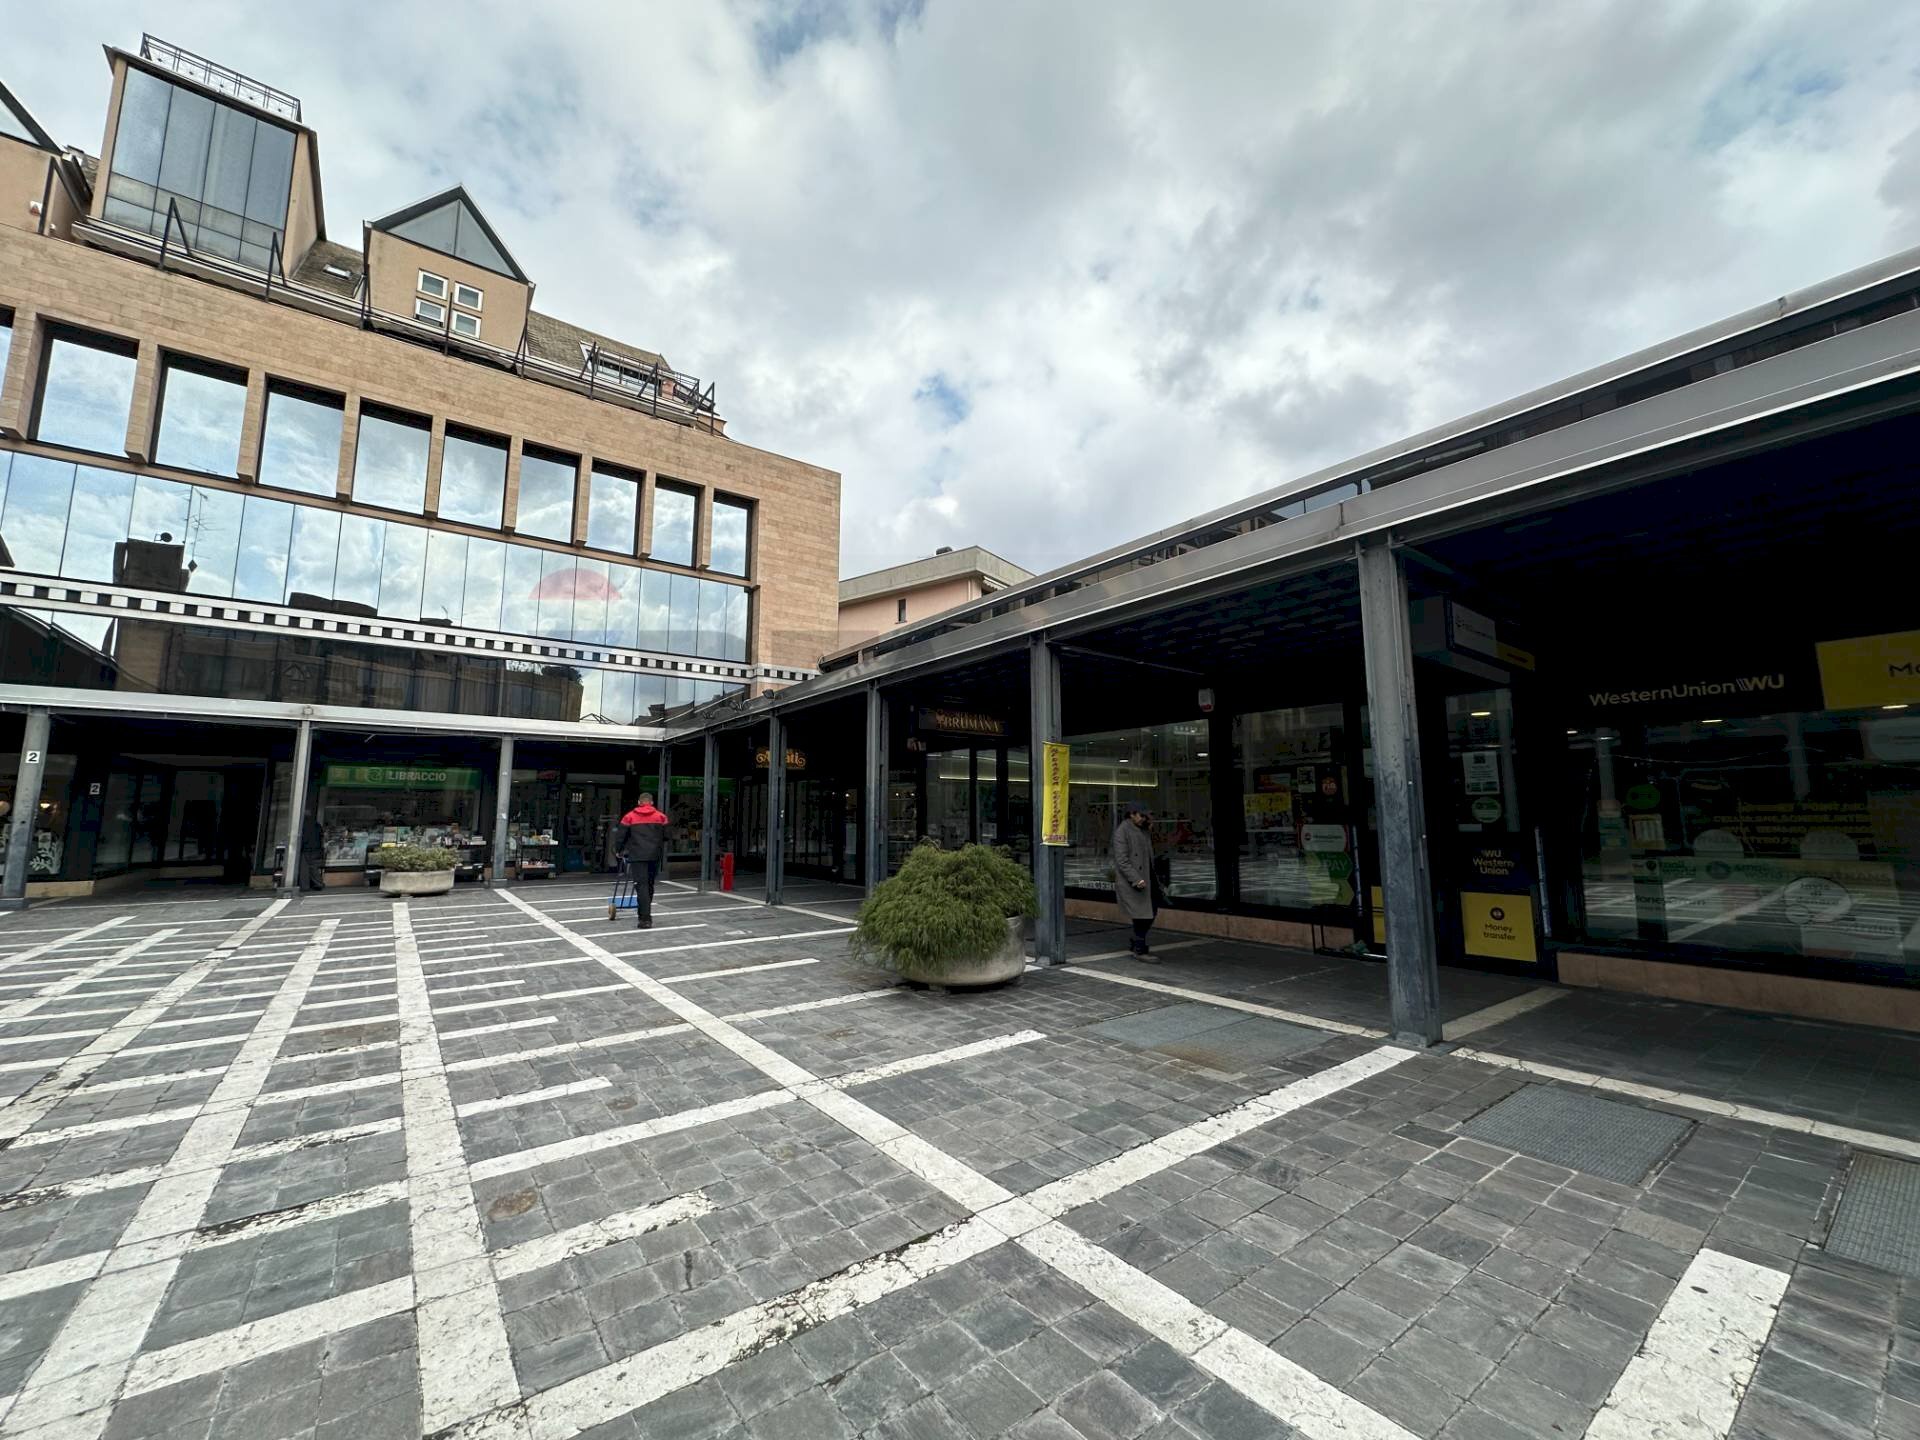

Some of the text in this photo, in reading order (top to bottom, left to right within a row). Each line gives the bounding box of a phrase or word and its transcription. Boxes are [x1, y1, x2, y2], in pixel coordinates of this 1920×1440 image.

[1588, 680, 1736, 708] WesternUnion
[27, 752, 38, 762] 2
[387, 770, 448, 782] LIBRACCIO
